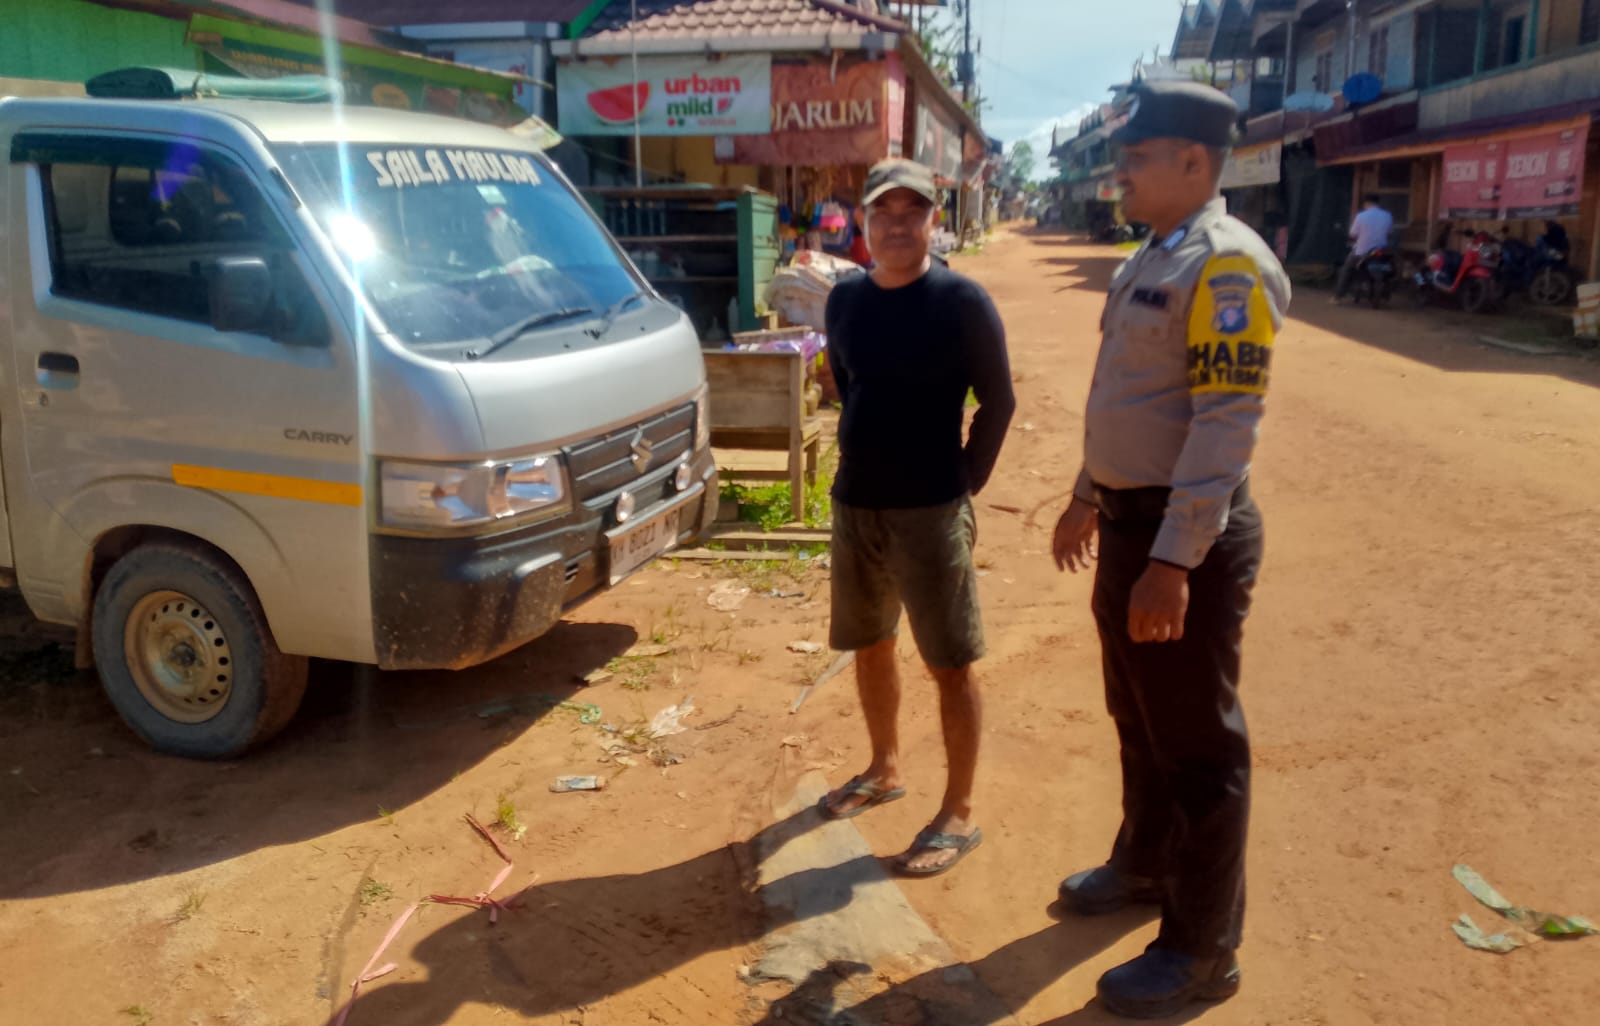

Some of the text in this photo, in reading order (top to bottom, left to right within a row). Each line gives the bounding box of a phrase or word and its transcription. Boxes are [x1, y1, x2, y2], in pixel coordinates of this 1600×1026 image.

[664, 74, 741, 95] urban
[667, 97, 713, 116] mild
[771, 98, 875, 131] JARUM
[283, 428, 354, 446] CARRY
